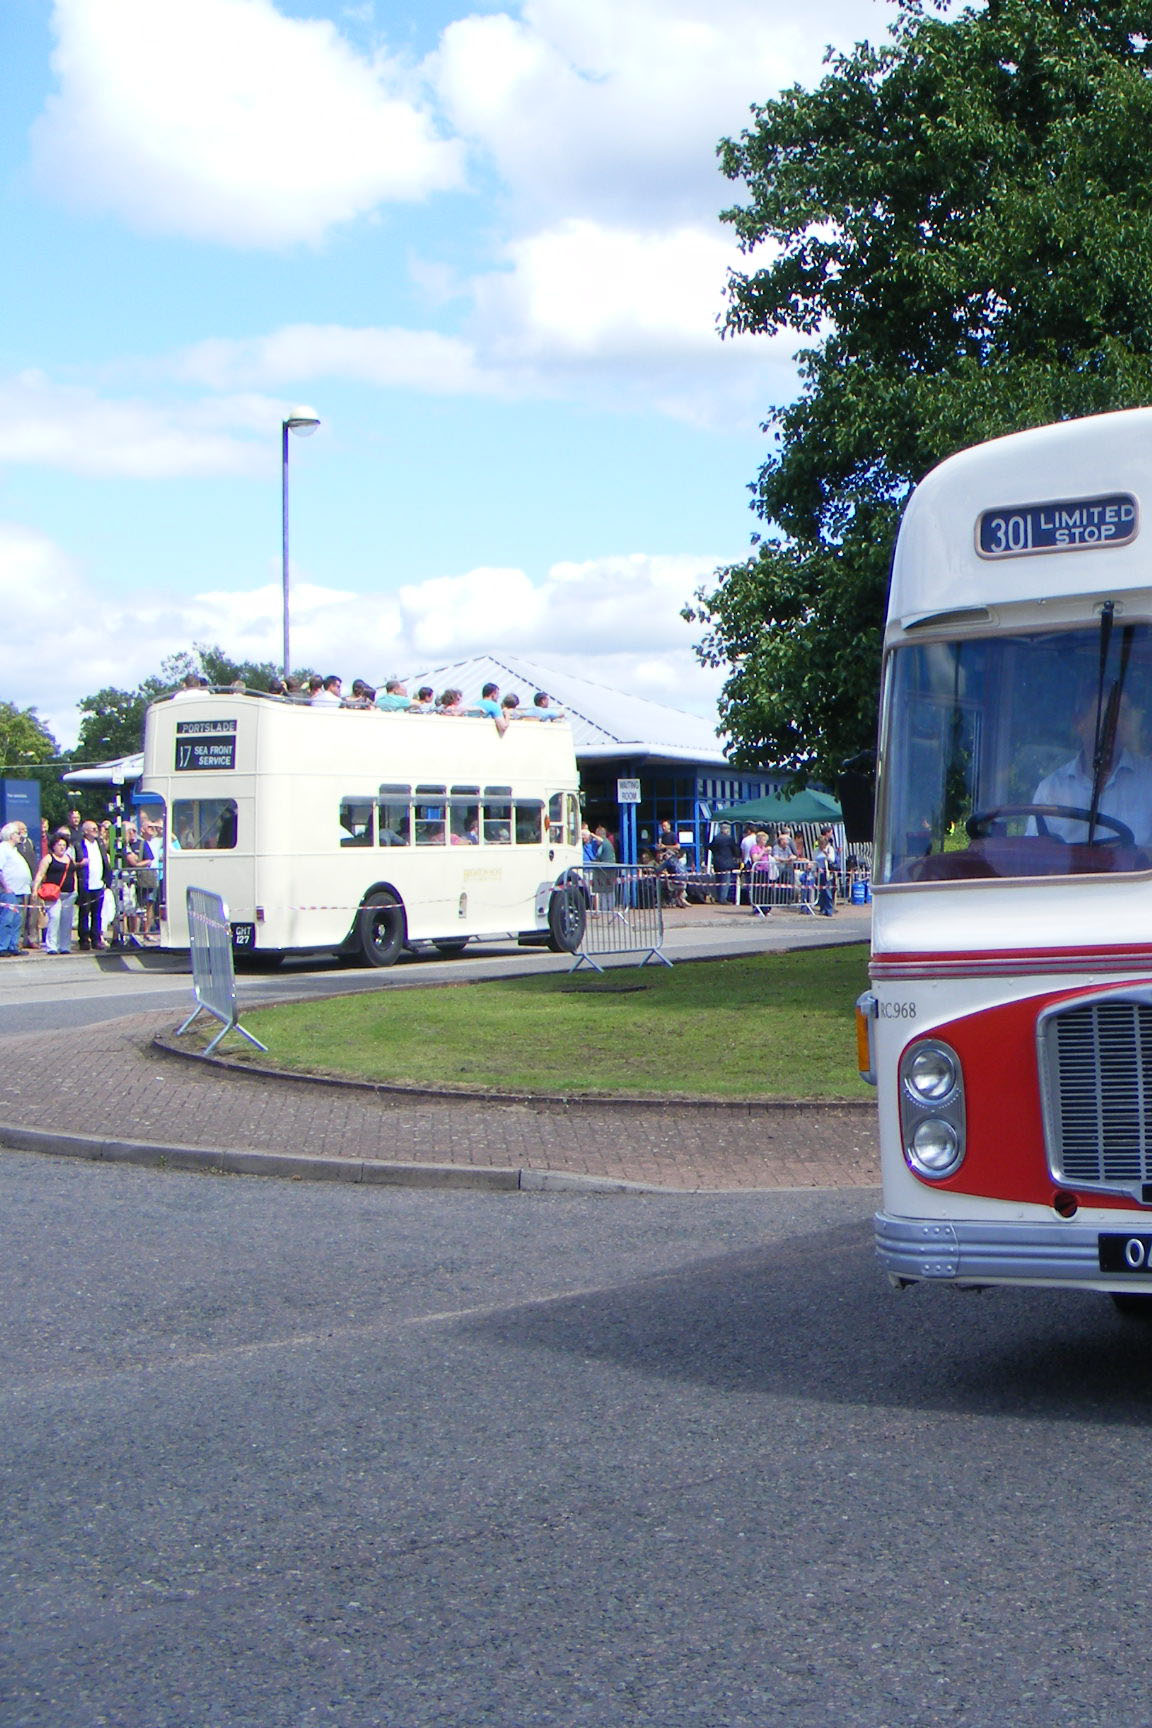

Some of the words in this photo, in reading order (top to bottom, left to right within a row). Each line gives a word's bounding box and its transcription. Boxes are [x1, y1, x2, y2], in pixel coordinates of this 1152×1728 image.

[990, 513, 1033, 553] 301
[1040, 504, 1134, 530] LIMITED
[1055, 524, 1116, 547] STOP
[181, 721, 236, 734] PORTSLADE
[179, 745, 192, 768] 17
[194, 745, 209, 755] SEA
[209, 745, 233, 755] FRONT
[198, 755, 232, 766] SERVICE
[621, 791, 637, 801] ROOM
[236, 935, 250, 945] 127
